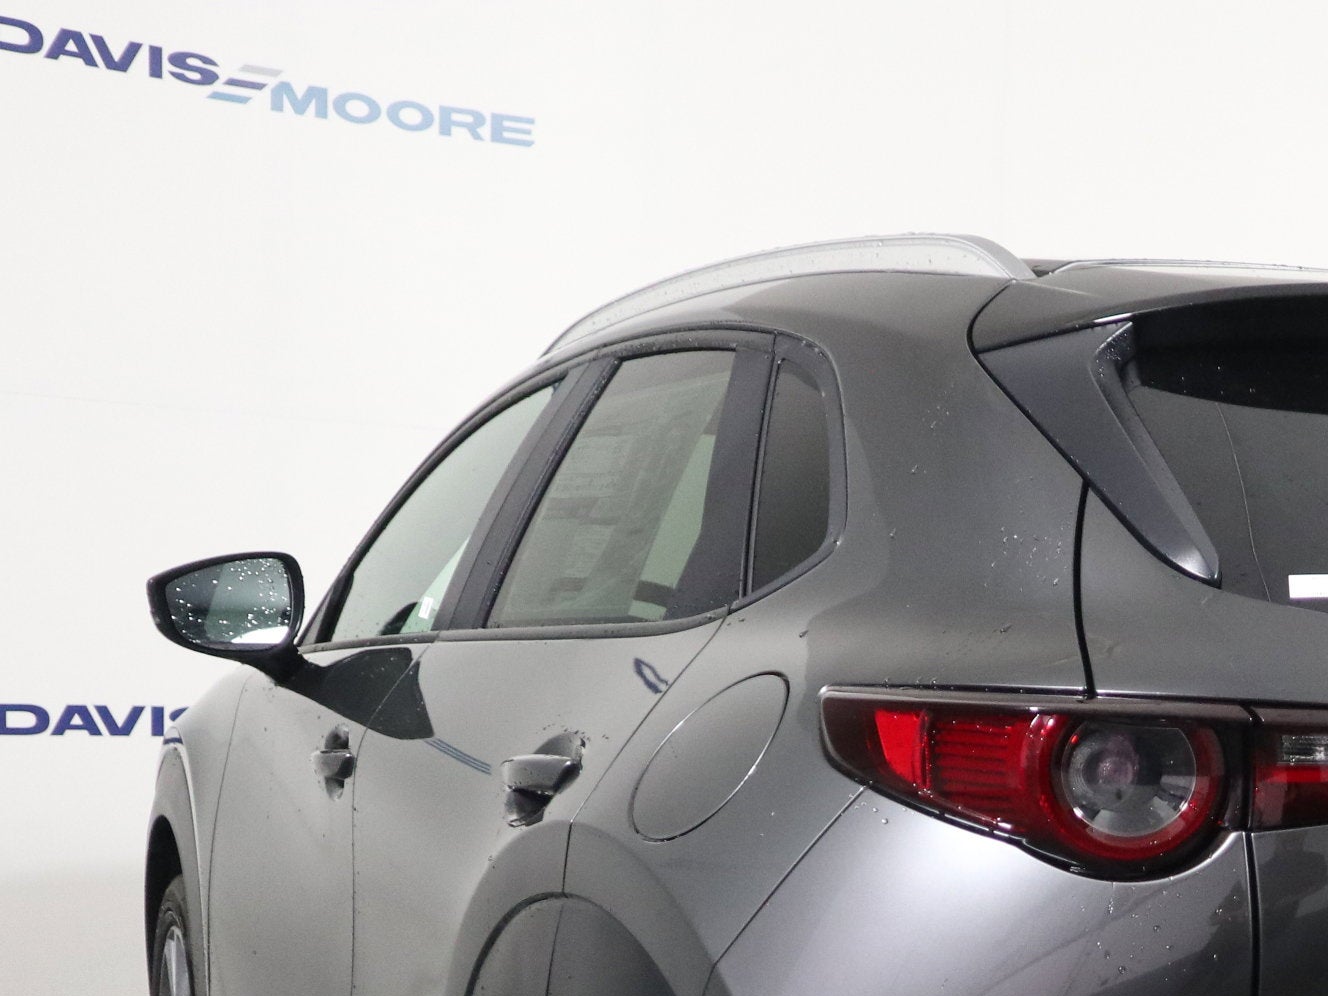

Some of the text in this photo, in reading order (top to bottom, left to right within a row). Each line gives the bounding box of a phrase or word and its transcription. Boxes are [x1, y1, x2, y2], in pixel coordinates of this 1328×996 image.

[0, 15, 535, 148] DAVIS MOORE
[0, 703, 190, 737] DAVI
